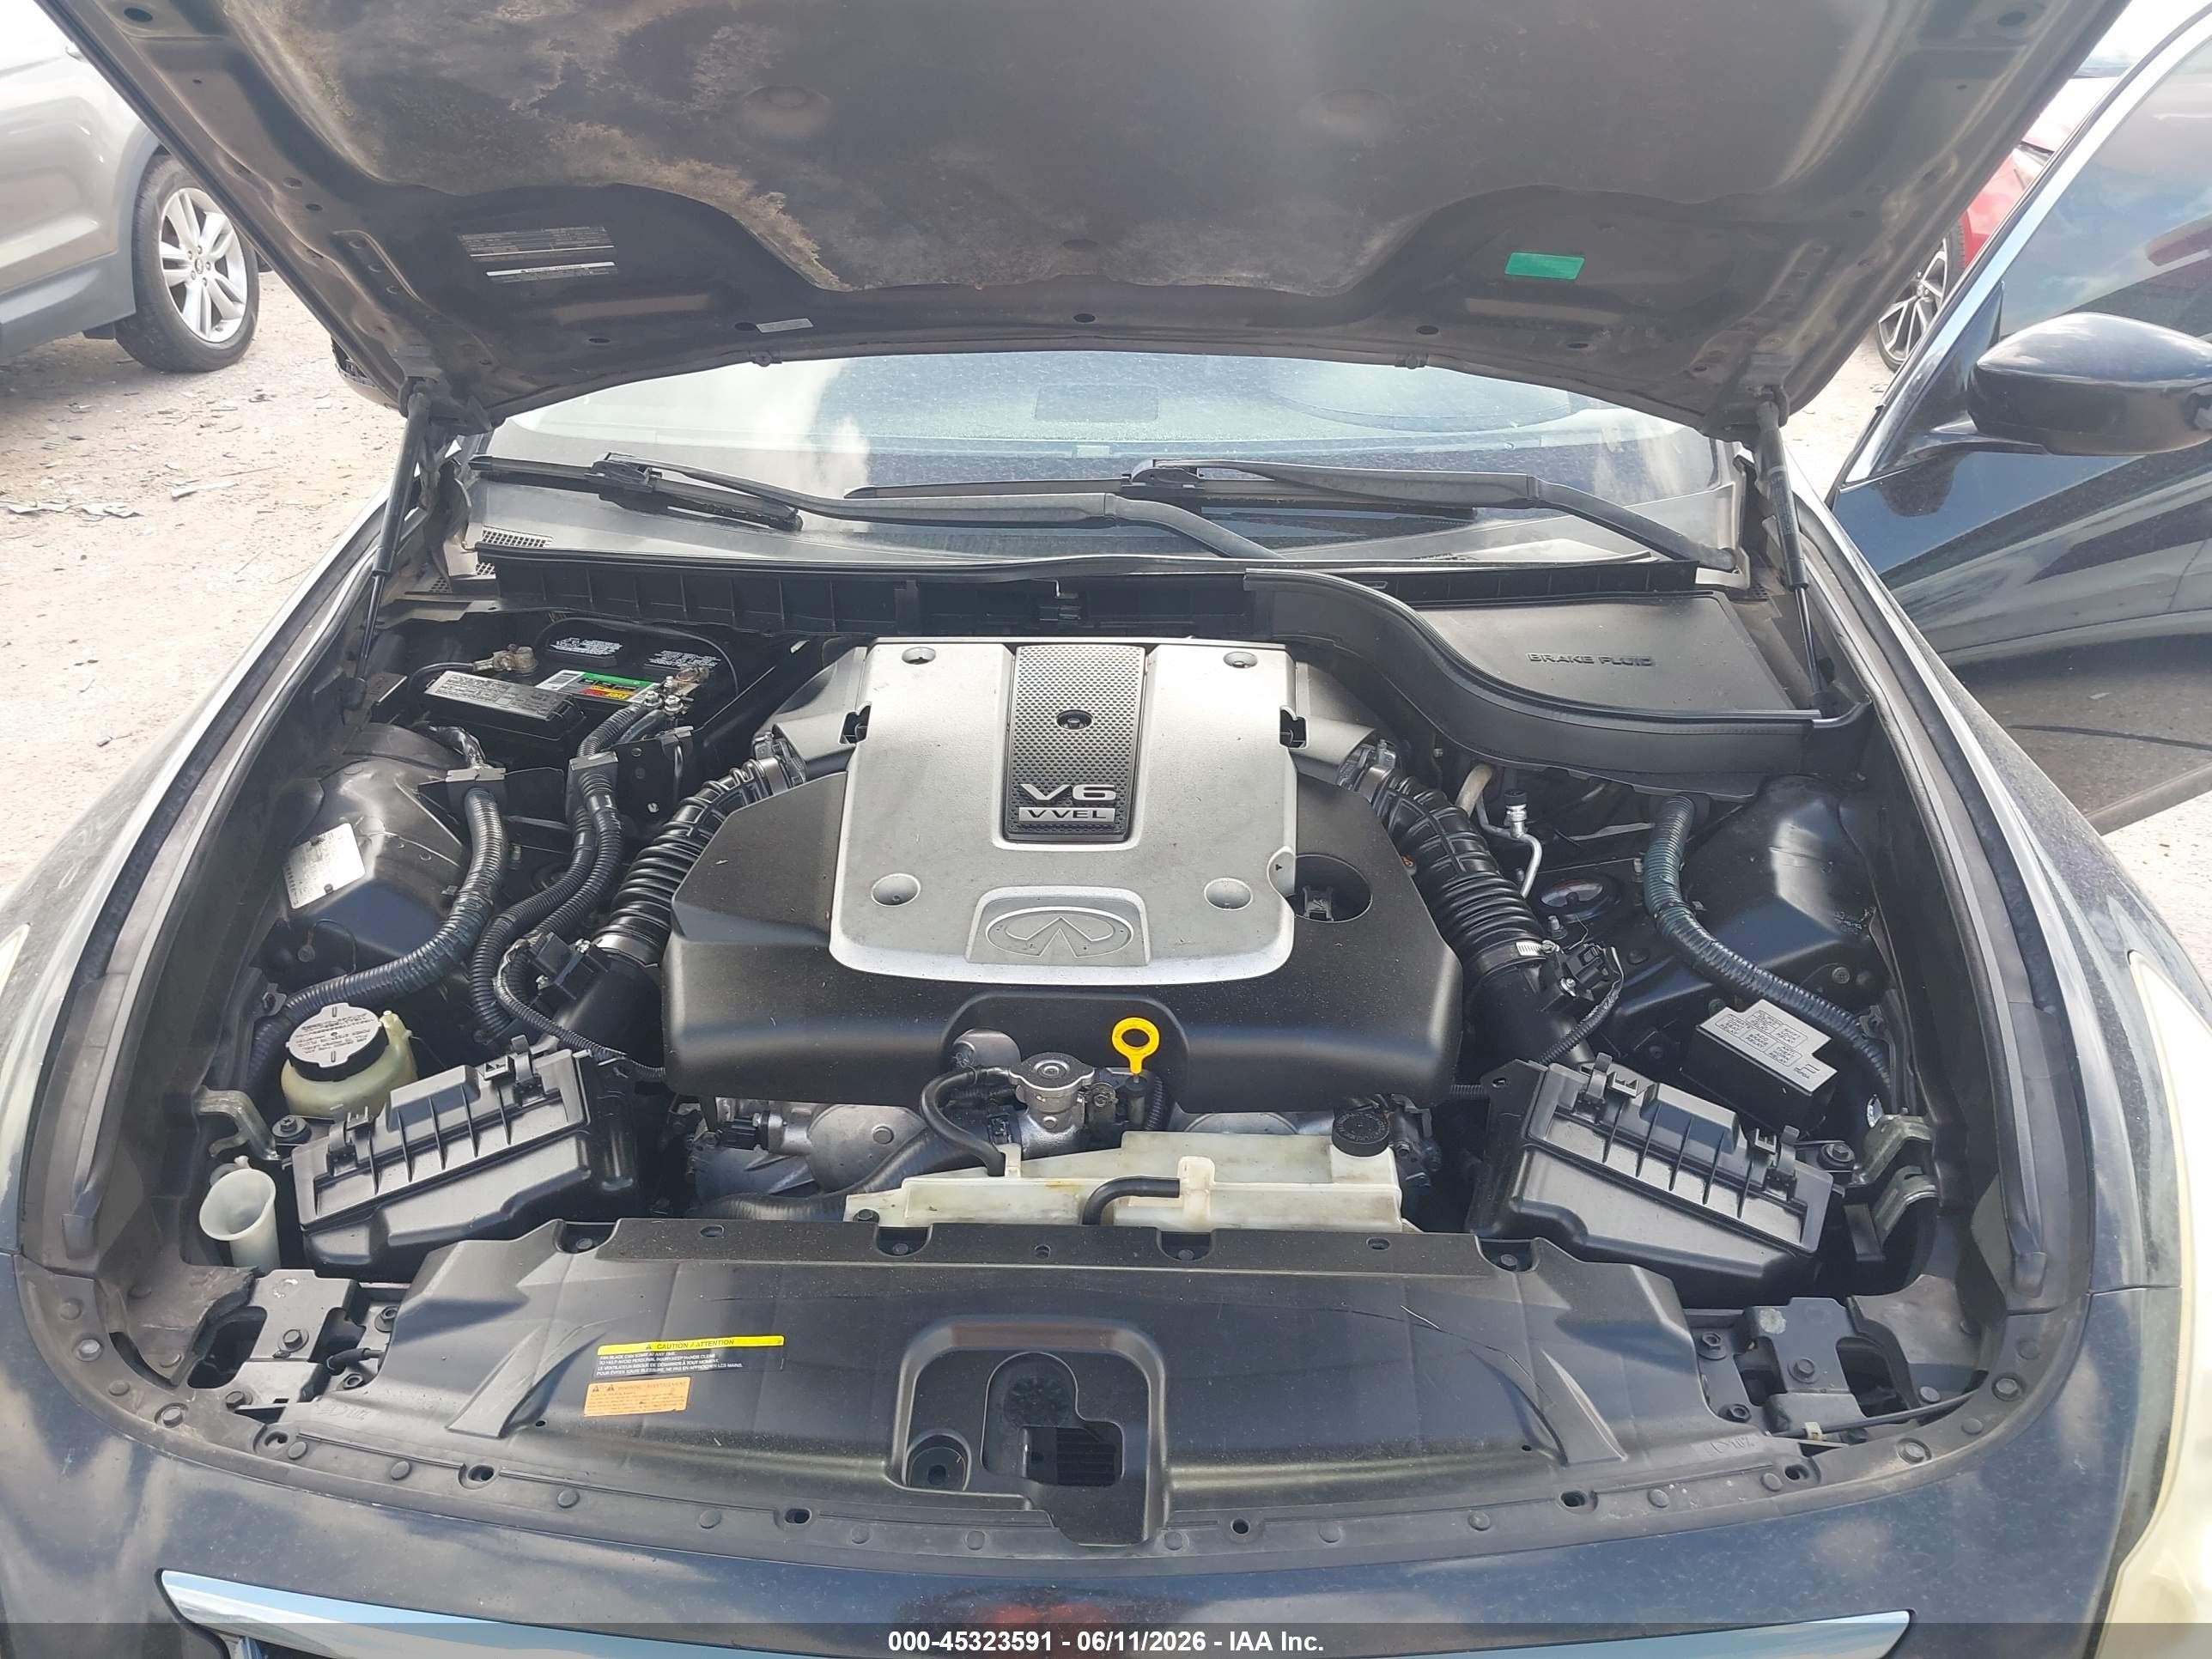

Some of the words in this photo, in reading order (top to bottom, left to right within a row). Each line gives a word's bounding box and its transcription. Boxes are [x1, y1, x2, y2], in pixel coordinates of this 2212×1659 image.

[1528, 653, 1595, 665] BRAKE
[1598, 656, 1653, 666] FLUID
[1020, 784, 1116, 801] V6
[1027, 810, 1107, 818] VVEL
[696, 1340, 735, 1348] ATTENTION
